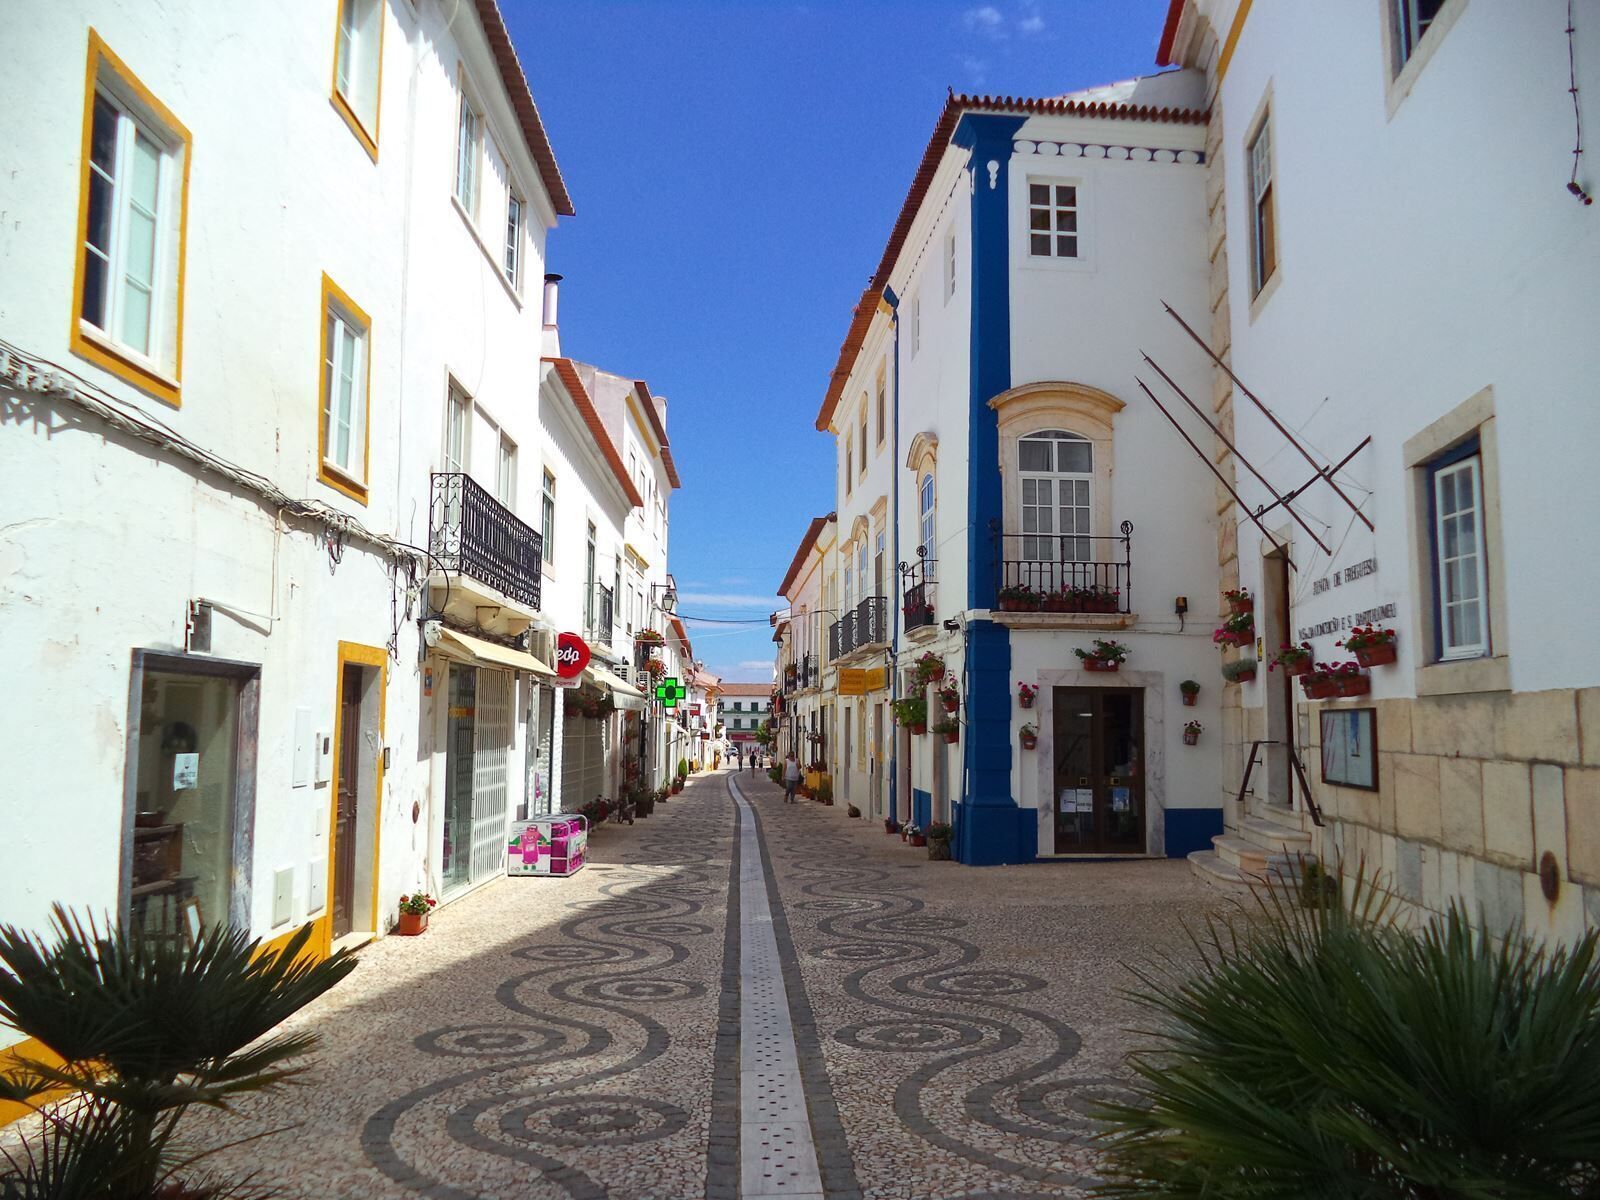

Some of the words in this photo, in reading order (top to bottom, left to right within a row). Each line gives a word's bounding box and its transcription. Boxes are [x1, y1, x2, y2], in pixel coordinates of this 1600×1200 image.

[1333, 571, 1342, 587] DE
[1341, 617, 1346, 630] E
[557, 646, 580, 665] edp
